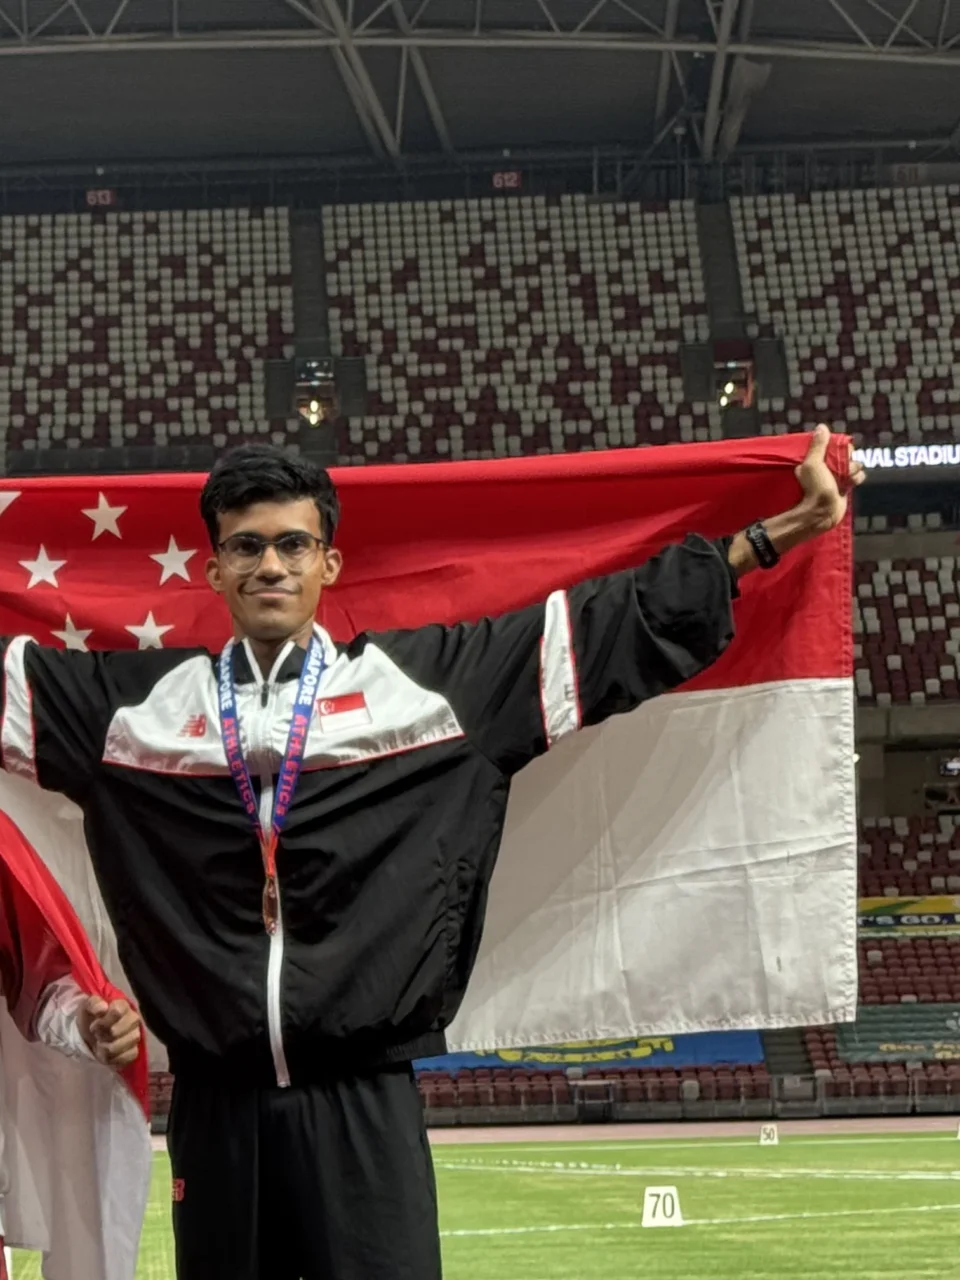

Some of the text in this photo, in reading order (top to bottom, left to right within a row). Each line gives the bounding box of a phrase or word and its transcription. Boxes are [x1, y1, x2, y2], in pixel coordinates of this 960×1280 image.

[222, 717, 254, 815] ATHLETICS
[275, 714, 308, 816] ATHLETICS
[762, 1127, 776, 1142] 50
[648, 1192, 676, 1219] 70
